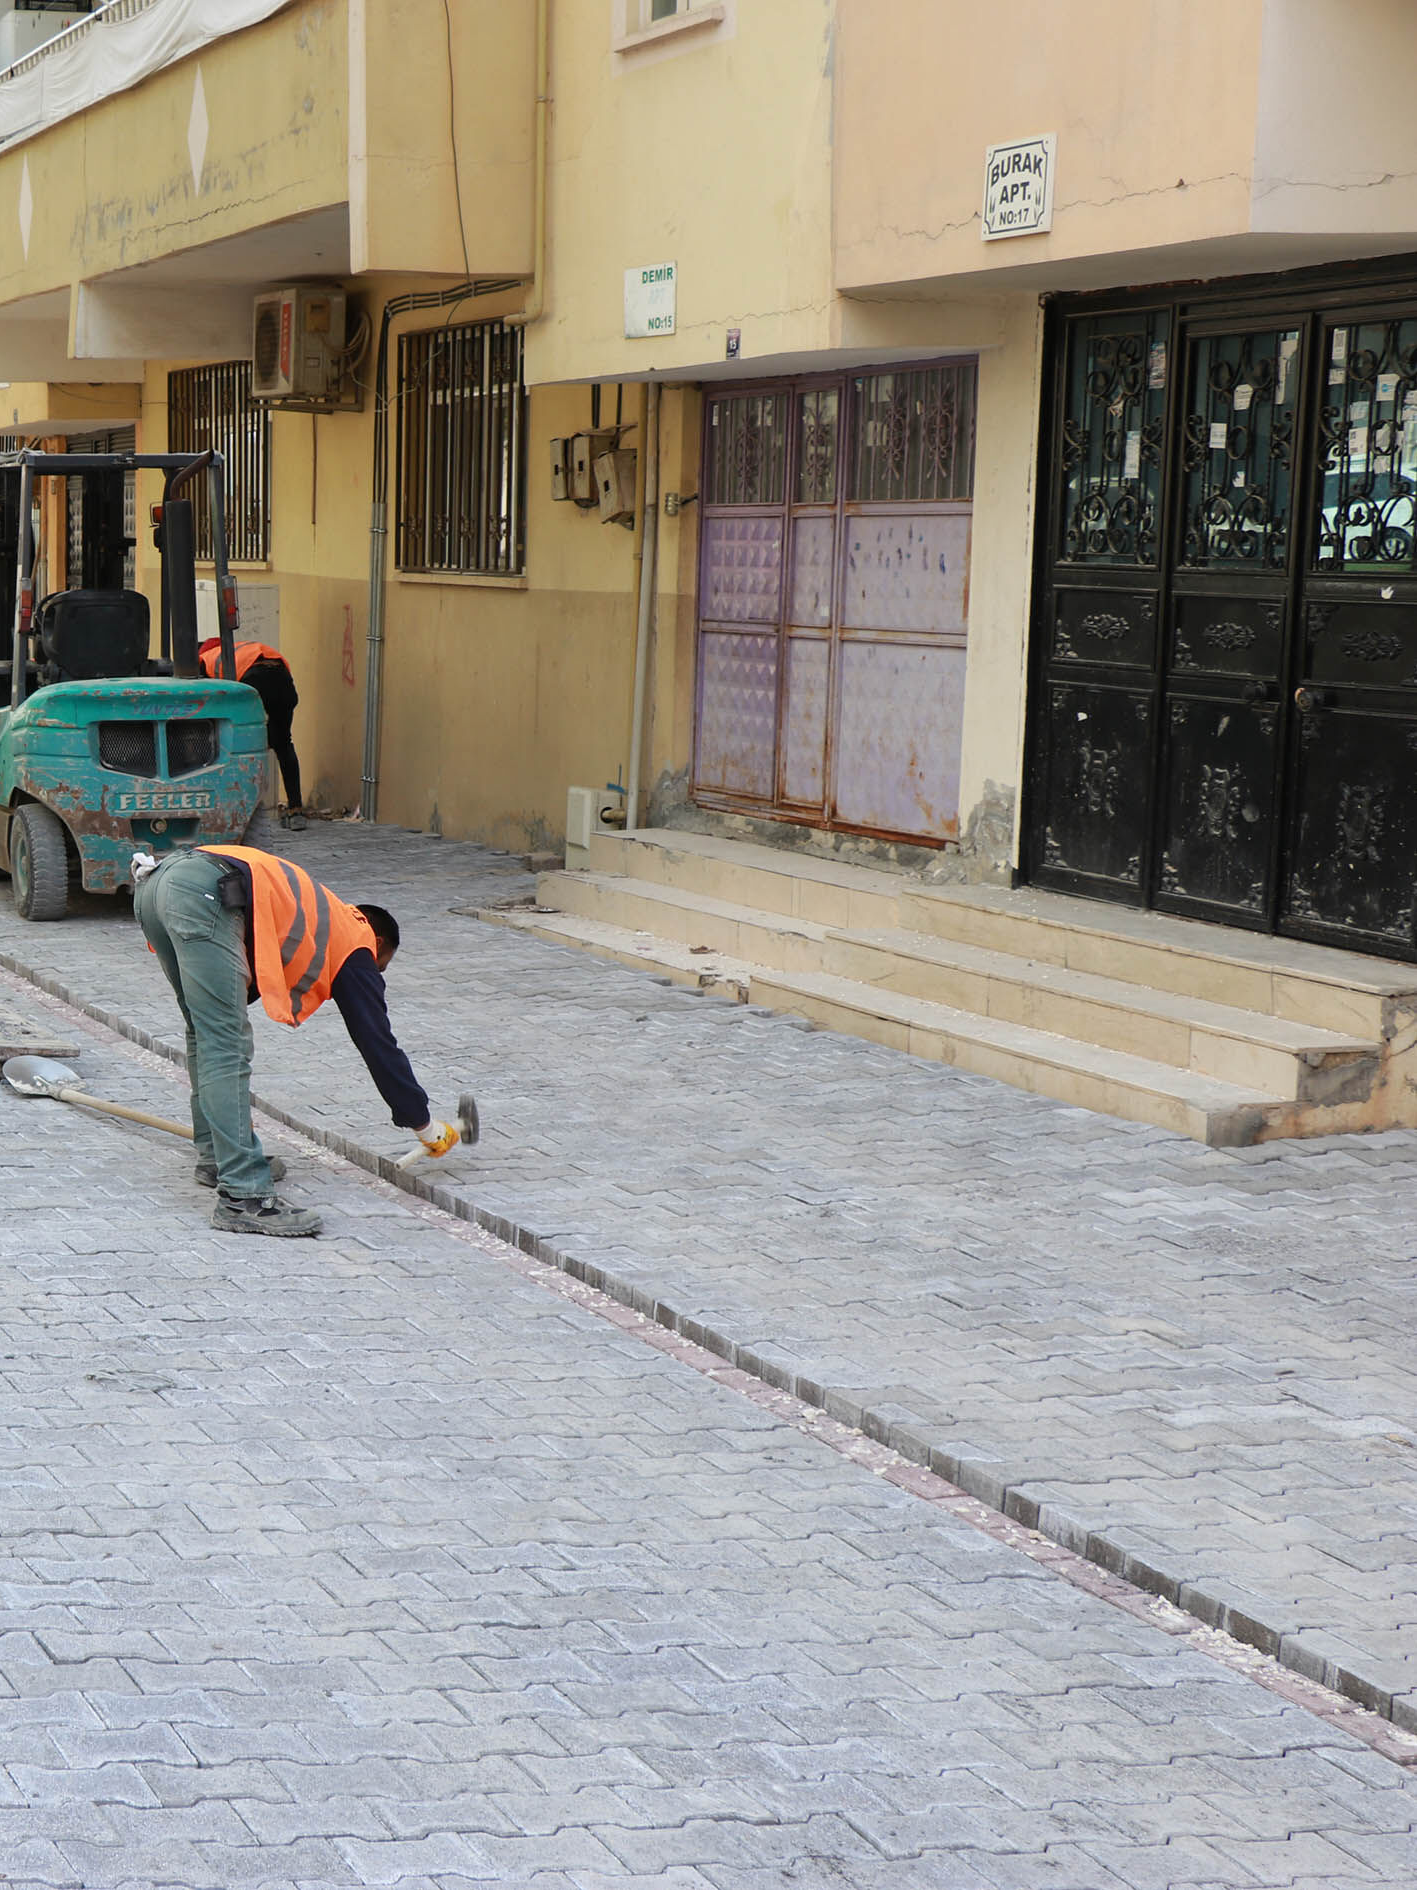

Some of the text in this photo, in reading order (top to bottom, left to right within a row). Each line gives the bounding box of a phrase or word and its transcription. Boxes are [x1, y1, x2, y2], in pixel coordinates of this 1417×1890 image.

[990, 152, 1043, 187] BURAK
[999, 181, 1031, 205] APT.
[999, 207, 1029, 226] NO:17
[641, 264, 674, 284] DEMİR
[647, 315, 673, 330] NO:15
[119, 792, 211, 810] FEELER
